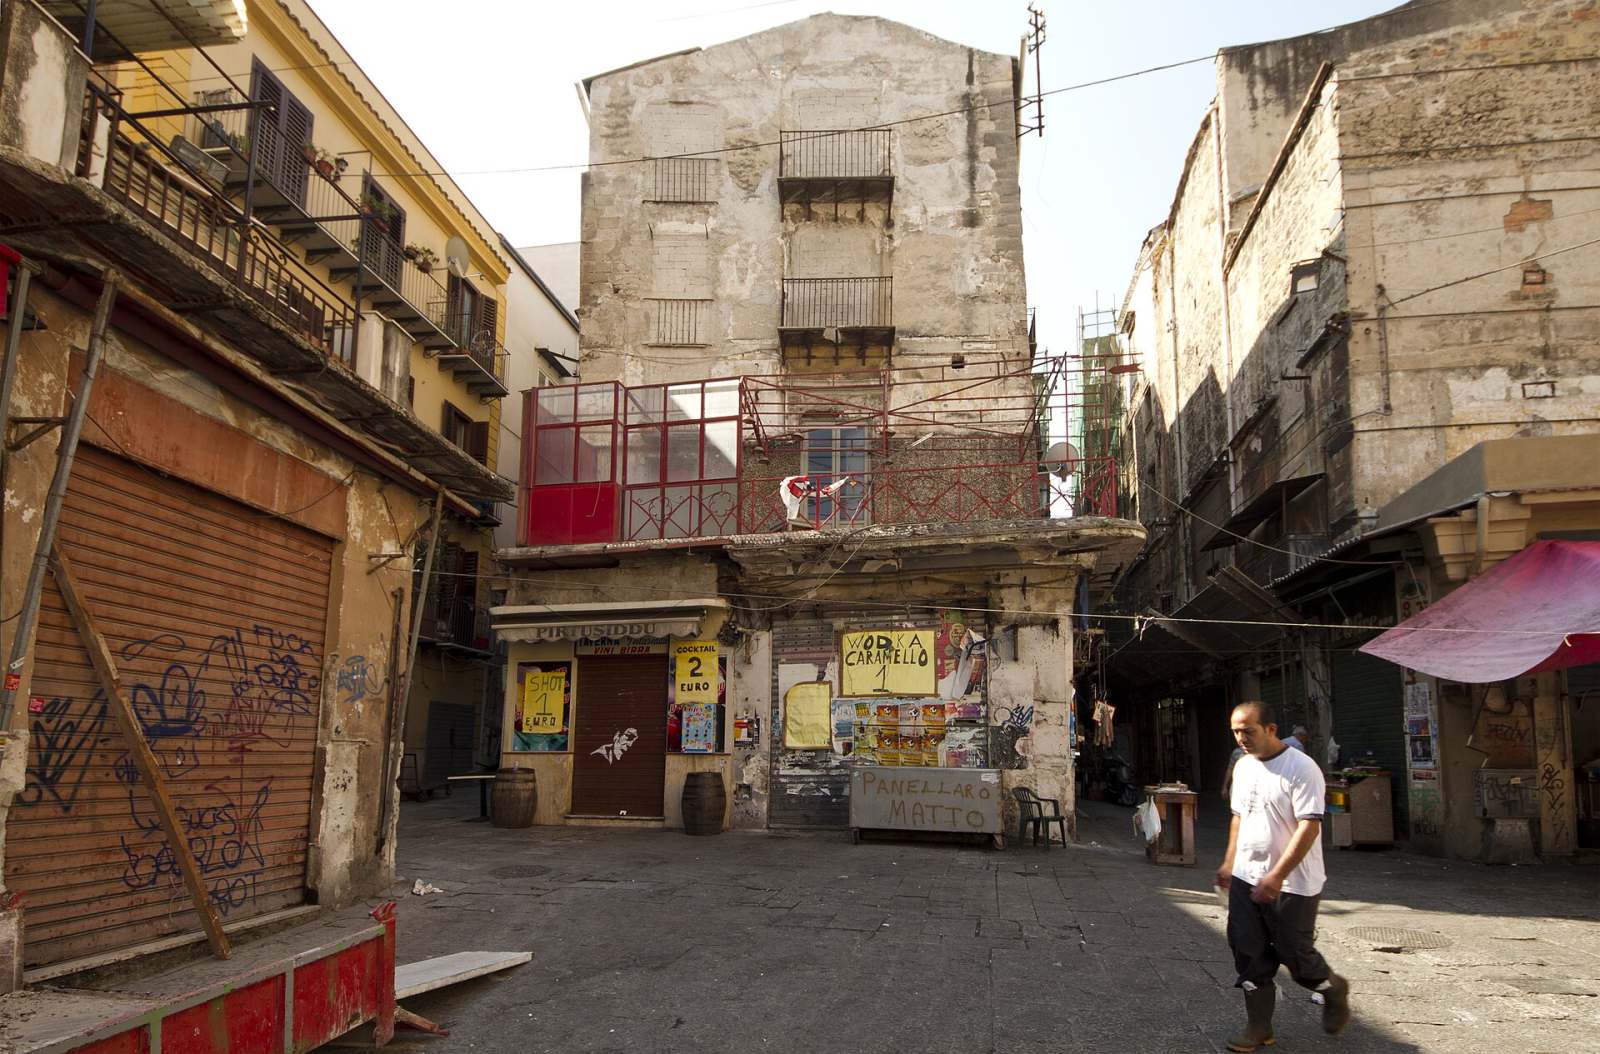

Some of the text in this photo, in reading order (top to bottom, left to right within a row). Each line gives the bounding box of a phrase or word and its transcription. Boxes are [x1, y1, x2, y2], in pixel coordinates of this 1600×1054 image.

[592, 645, 651, 655] VINI BIRRA
[676, 645, 716, 654] COCKTAIL
[848, 632, 923, 651] WODKA
[688, 656, 703, 677] 2
[845, 649, 928, 667] CARAMELLO
[530, 675, 564, 692] SHOT
[680, 682, 710, 692] EURO
[872, 665, 890, 693] 1
[535, 692, 553, 716] 1
[525, 716, 556, 727] EURO
[863, 770, 990, 800] PANELLARO
[889, 801, 984, 827] MATTO
